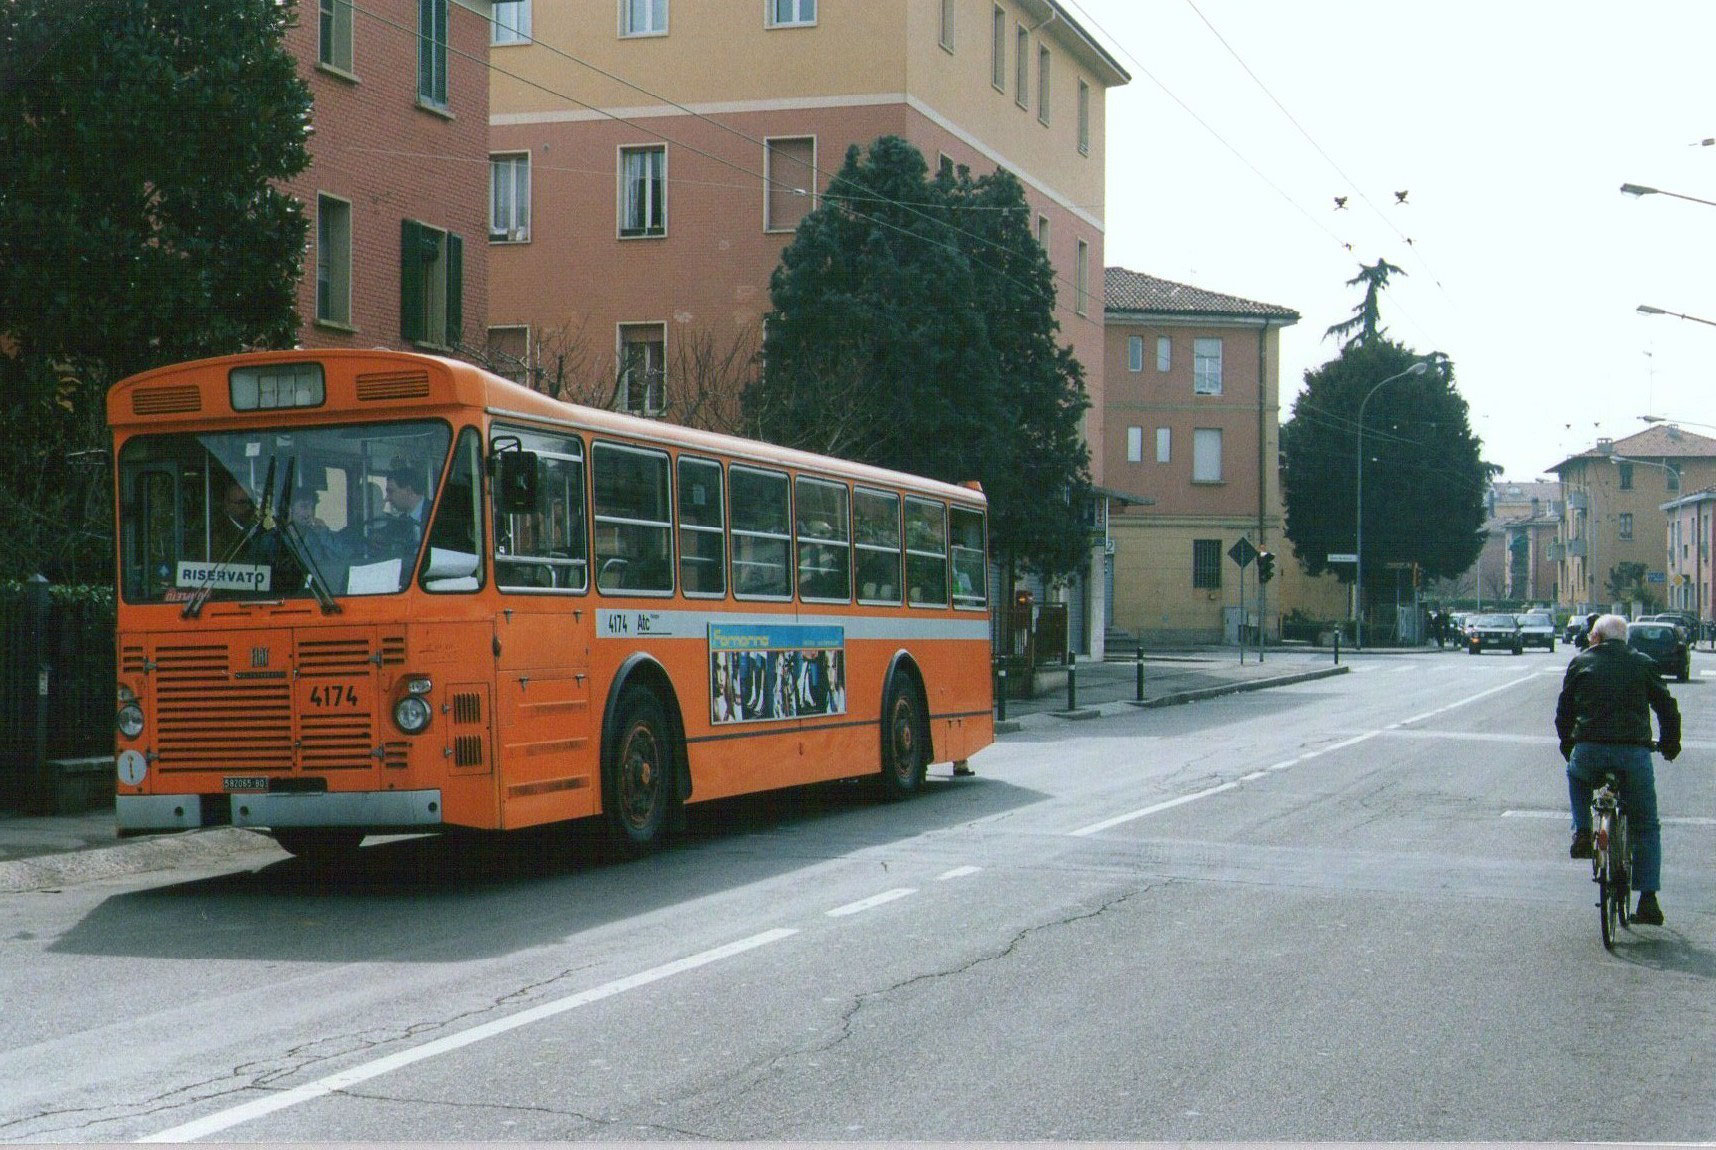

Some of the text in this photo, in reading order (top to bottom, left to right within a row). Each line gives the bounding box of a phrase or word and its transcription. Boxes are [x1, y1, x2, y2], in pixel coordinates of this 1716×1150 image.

[182, 568, 265, 584] RISERVATO
[608, 614, 650, 633] 4174 Atc
[310, 685, 358, 707] 4174
